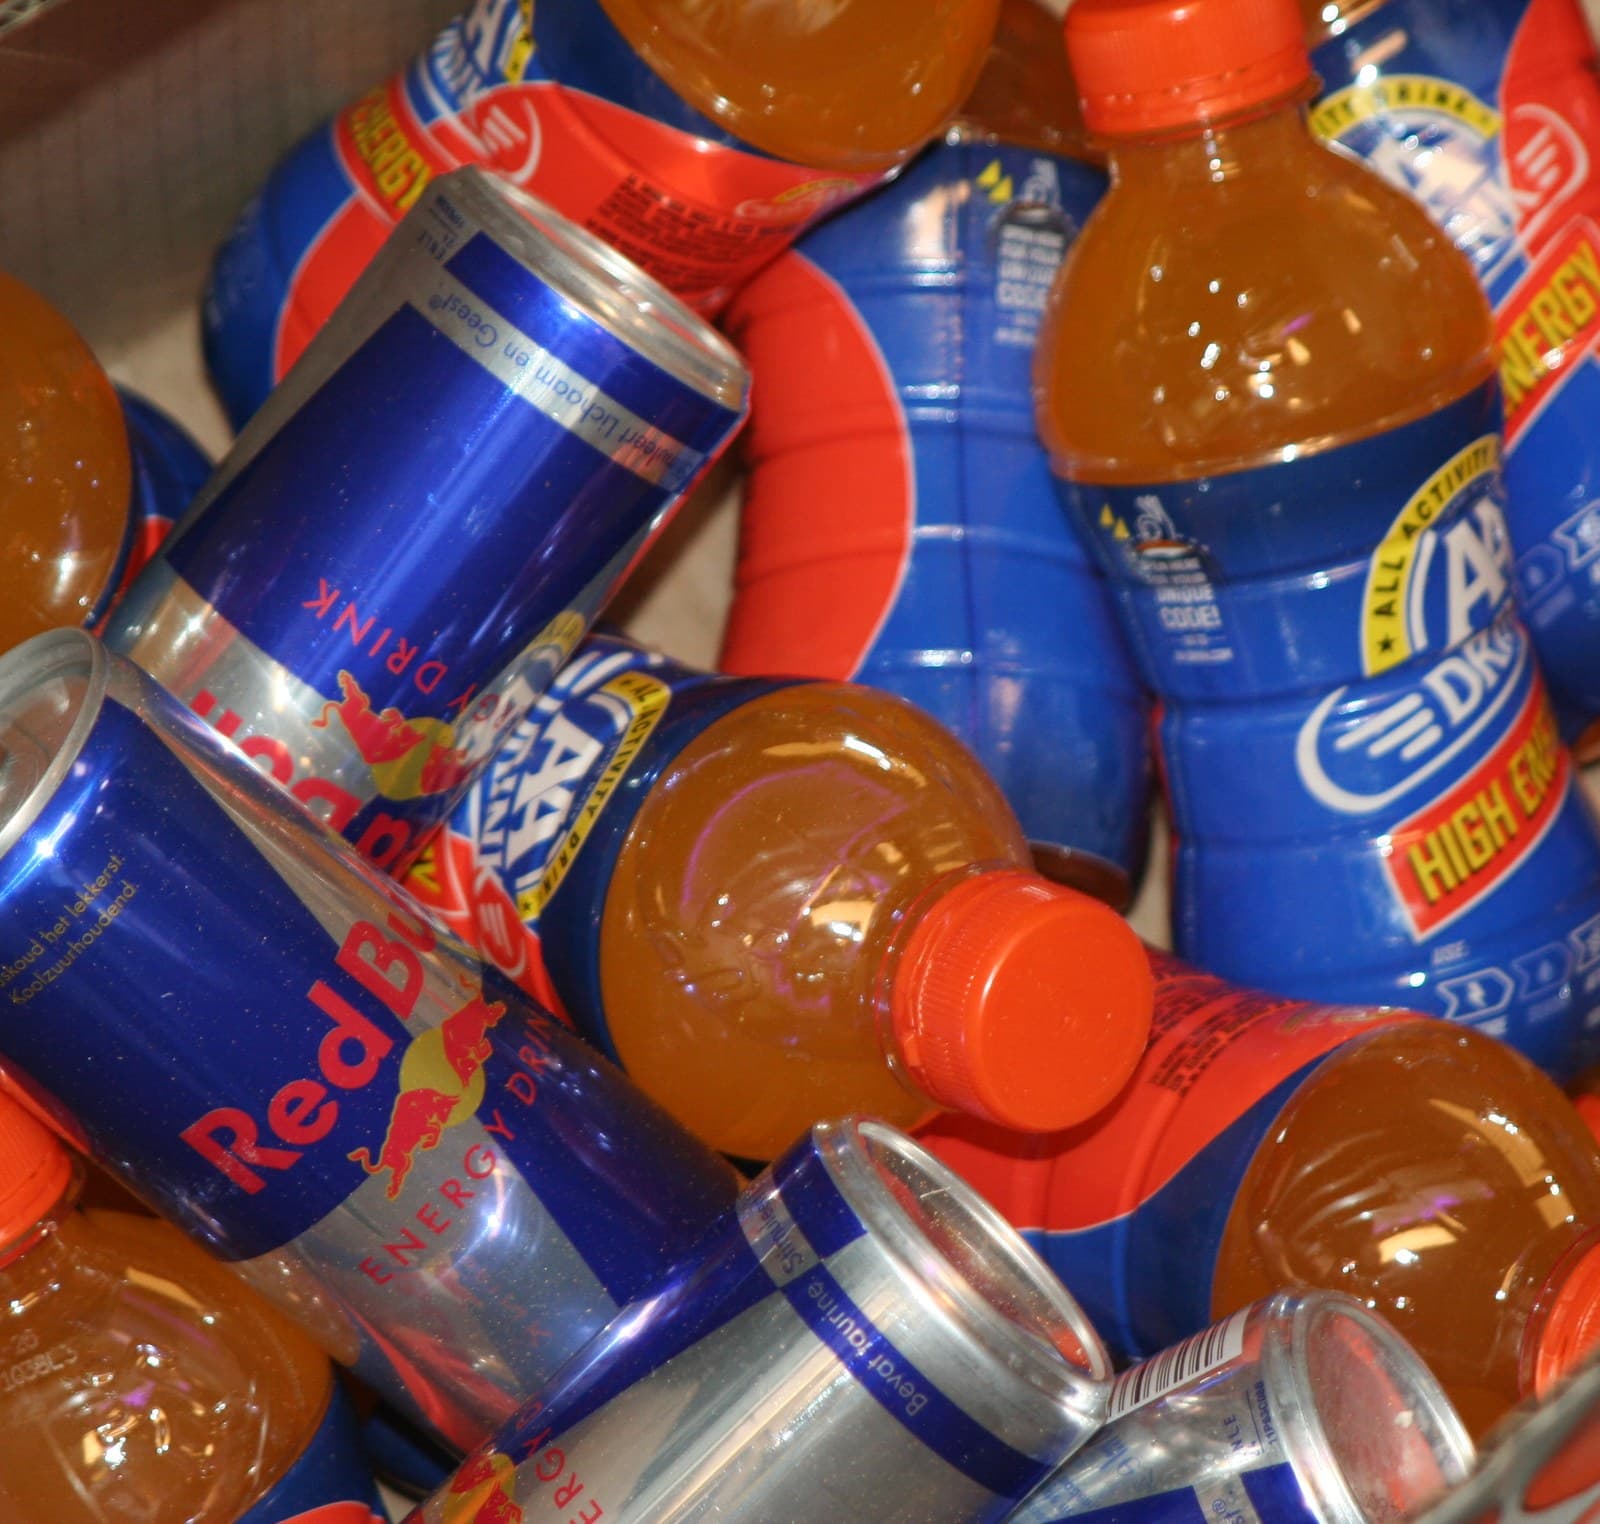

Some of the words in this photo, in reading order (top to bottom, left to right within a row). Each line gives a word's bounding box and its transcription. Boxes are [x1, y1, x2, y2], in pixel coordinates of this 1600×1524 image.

[503, 341, 531, 367] en
[1503, 240, 1600, 418] NERGY
[535, 366, 620, 439] Lichaam
[1159, 605, 1222, 629] CODE!
[1373, 557, 1406, 617] ALL
[303, 578, 447, 695] DRINK
[504, 708, 605, 871] AA
[587, 706, 660, 818] ACTIVITY
[1407, 777, 1518, 905] HIGH
[38, 915, 71, 943] het
[179, 979, 397, 1196] Red
[335, 905, 437, 1021] Bu
[358, 1109, 516, 1286] ENERGY
[505, 1012, 554, 1105] DRIN
[807, 1275, 884, 1357] taurine.
[869, 1354, 929, 1417] Bevat
